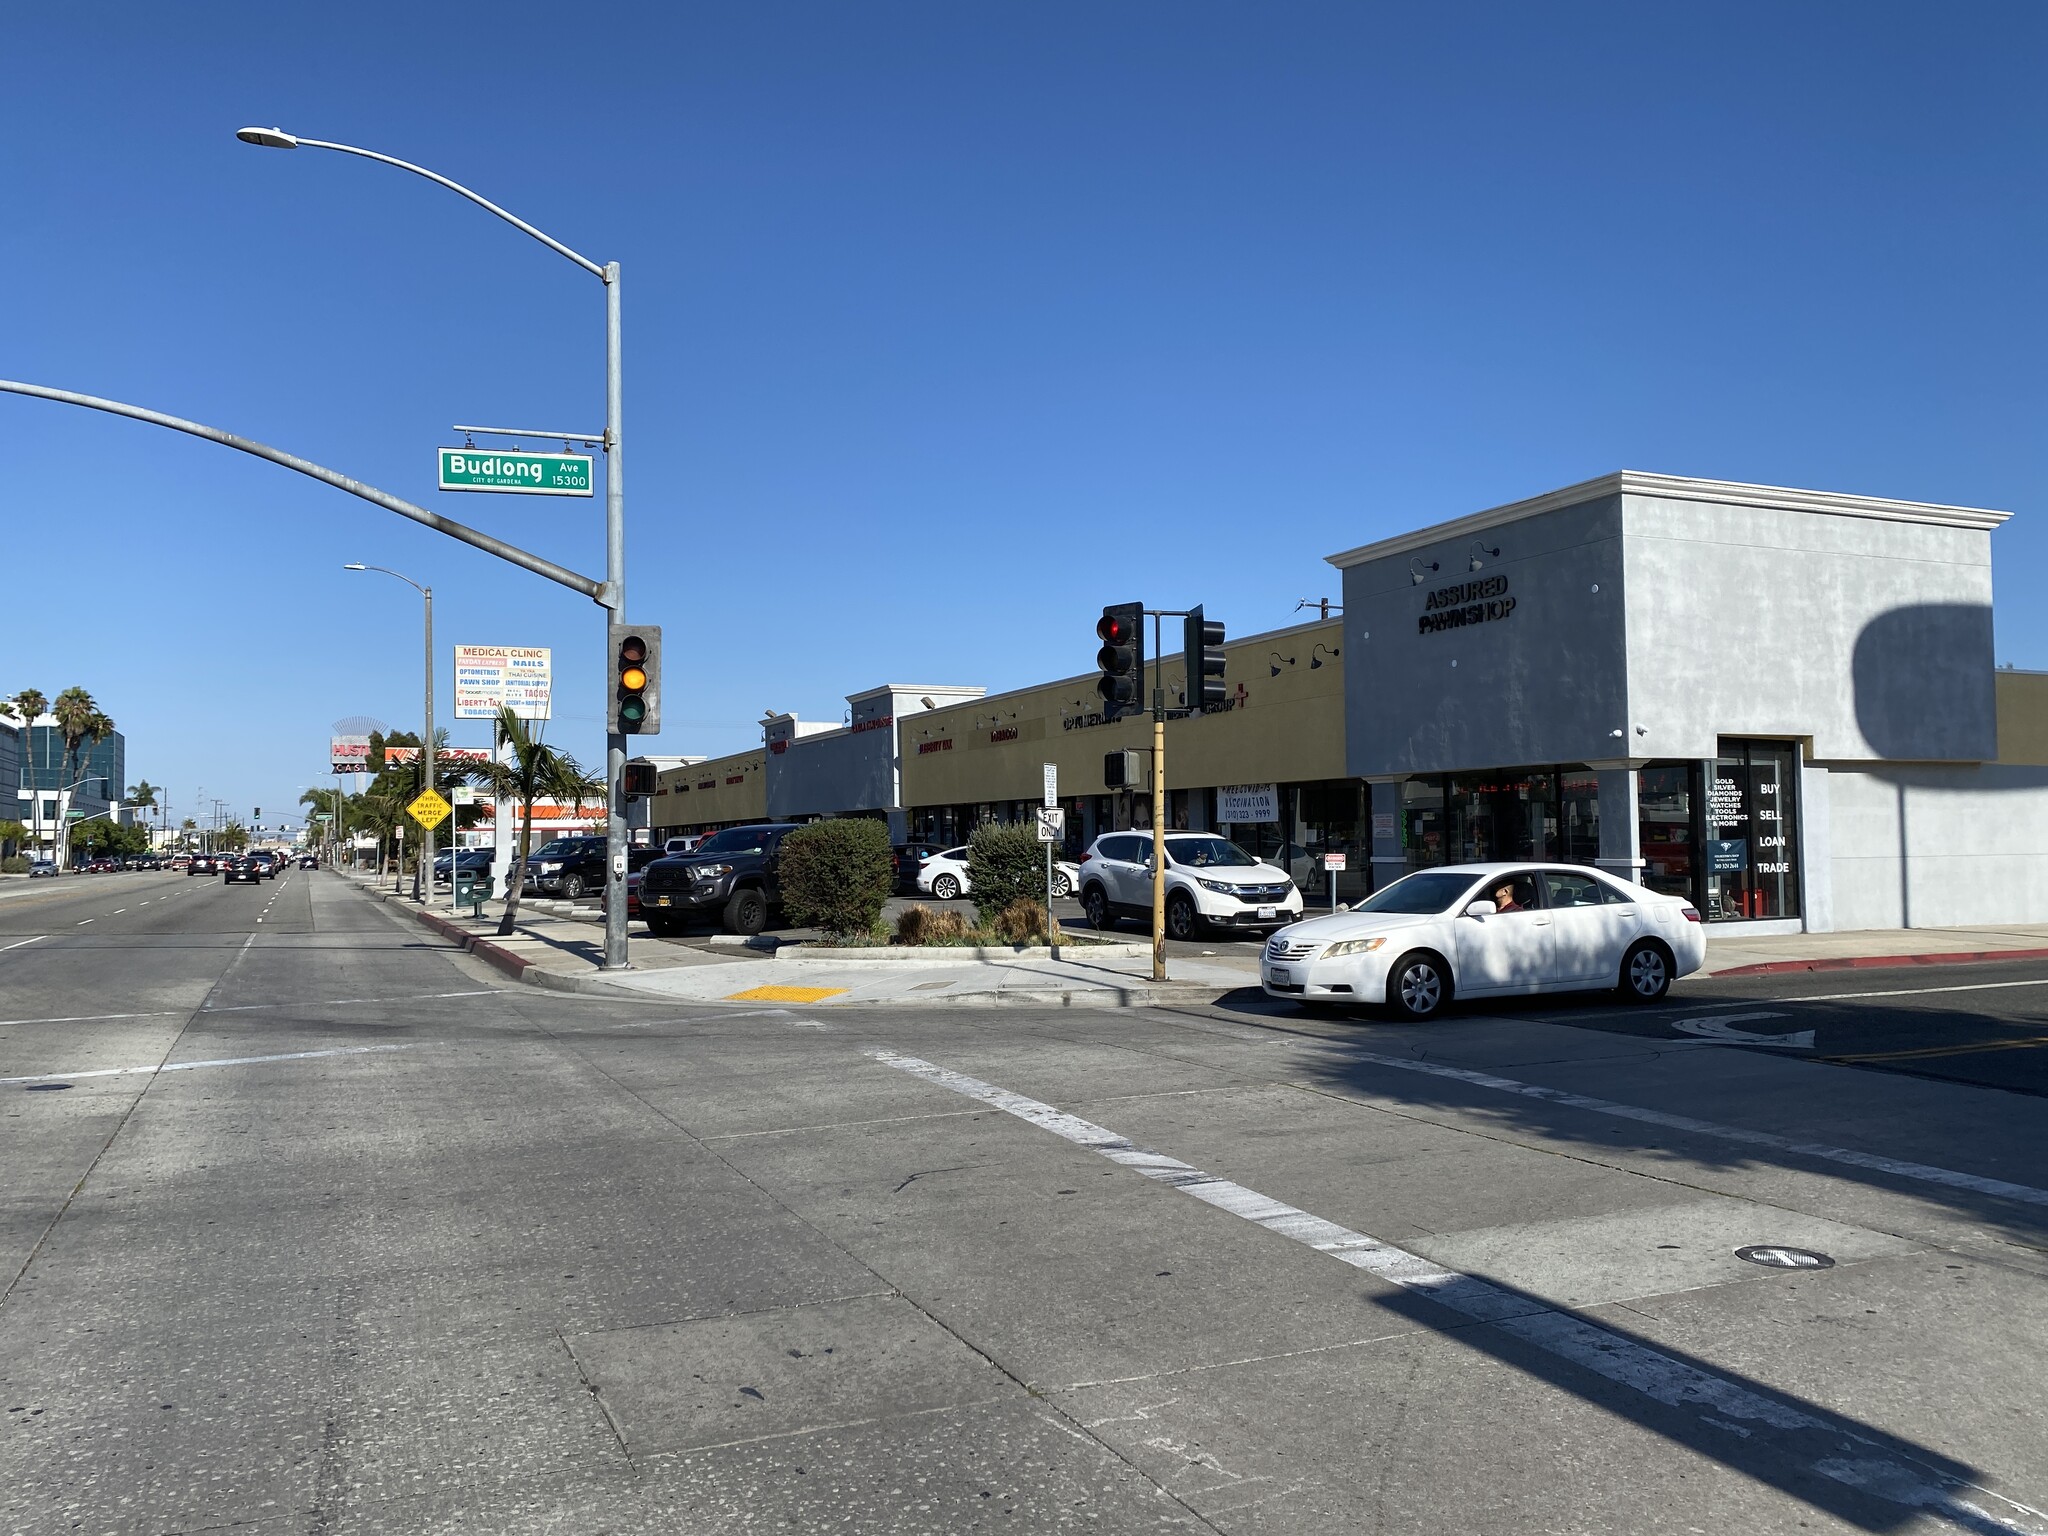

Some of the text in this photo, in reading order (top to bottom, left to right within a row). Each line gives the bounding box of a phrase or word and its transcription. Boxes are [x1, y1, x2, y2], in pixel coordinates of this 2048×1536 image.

[450, 455, 542, 483] Budlong
[559, 462, 579, 473] Ave
[552, 475, 586, 486] 15300
[1425, 575, 1508, 611] ASSURED
[463, 648, 543, 658] MEDICAL CLINIC
[459, 668, 500, 676] OPTOMETRIST
[524, 690, 548, 698] TACOS
[457, 697, 502, 707] LIBERTY TAX
[336, 764, 367, 772] CASI
[1761, 784, 1780, 795] BUY
[1043, 813, 1059, 823] EXIT
[1760, 810, 1783, 820] SELL
[1041, 827, 1060, 837] ONLY
[1759, 836, 1786, 847] LOAN
[1757, 863, 1790, 873] TRADE
